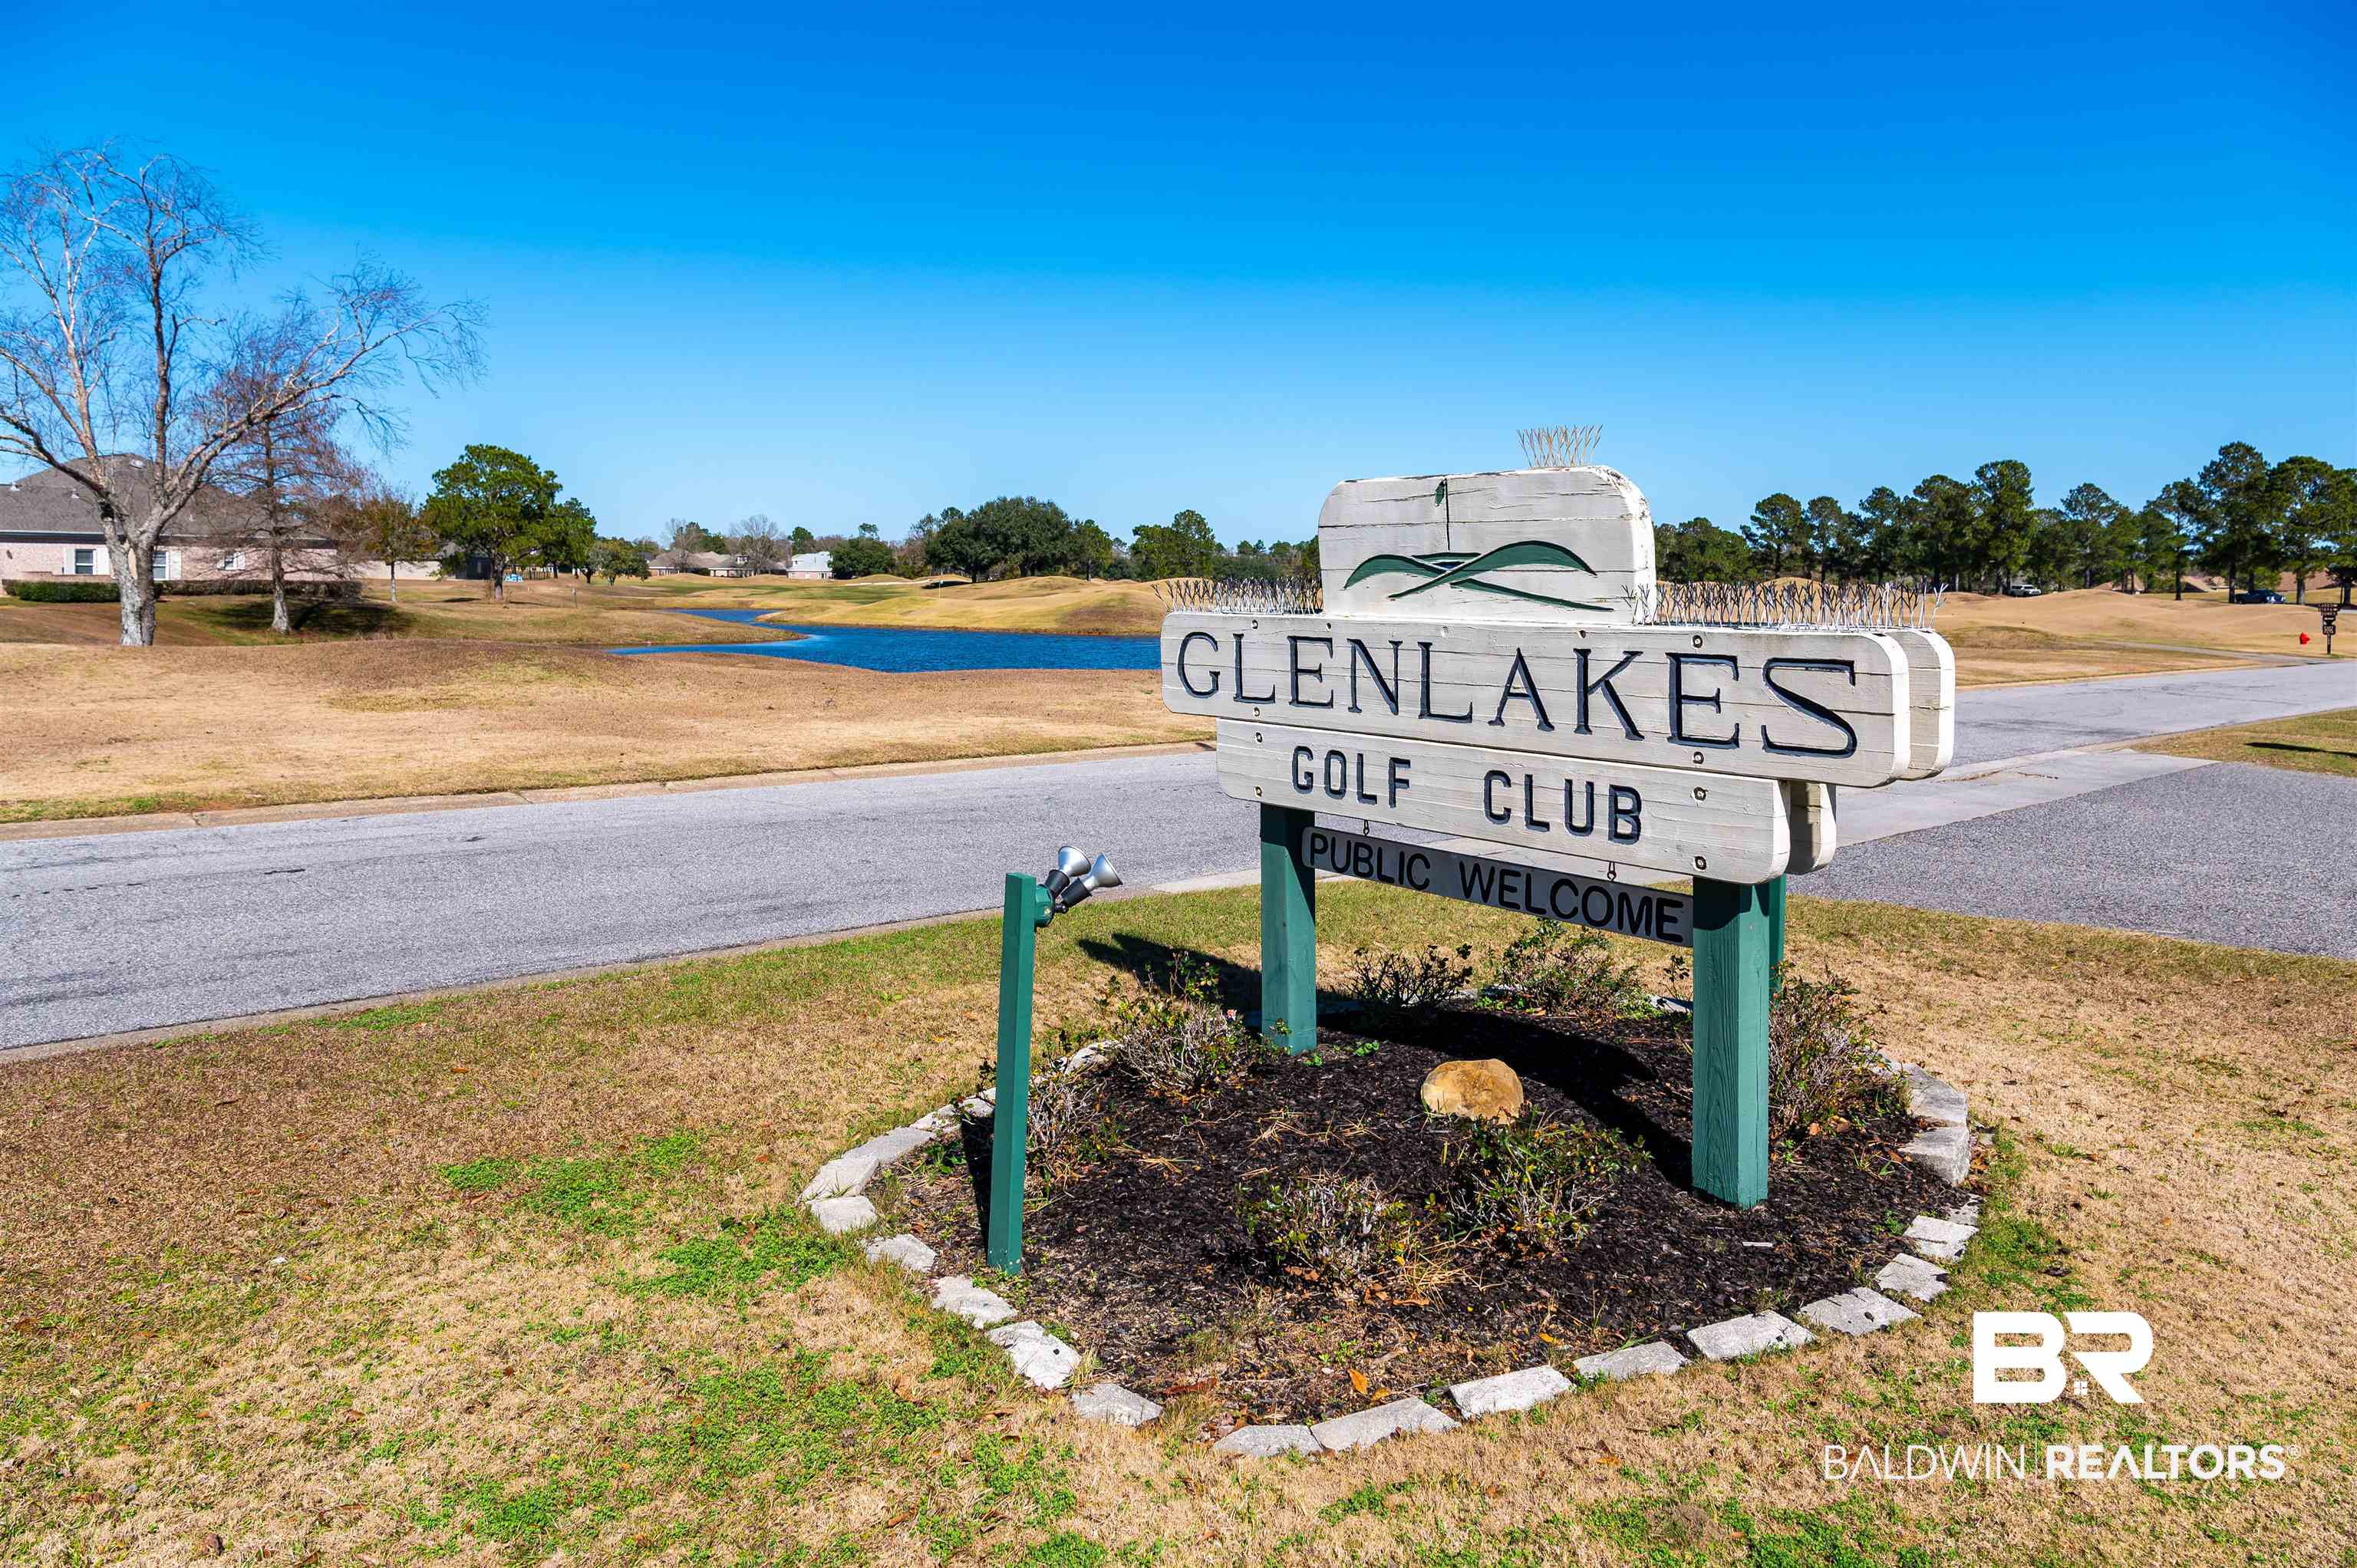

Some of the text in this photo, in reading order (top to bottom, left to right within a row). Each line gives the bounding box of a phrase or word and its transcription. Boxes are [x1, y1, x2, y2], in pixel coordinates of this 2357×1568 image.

[1176, 631, 1858, 758] GLENLAKES
[1291, 745, 1643, 845] GOLF CLUB
[1309, 832, 1685, 940] PUBLIC WELCOME
